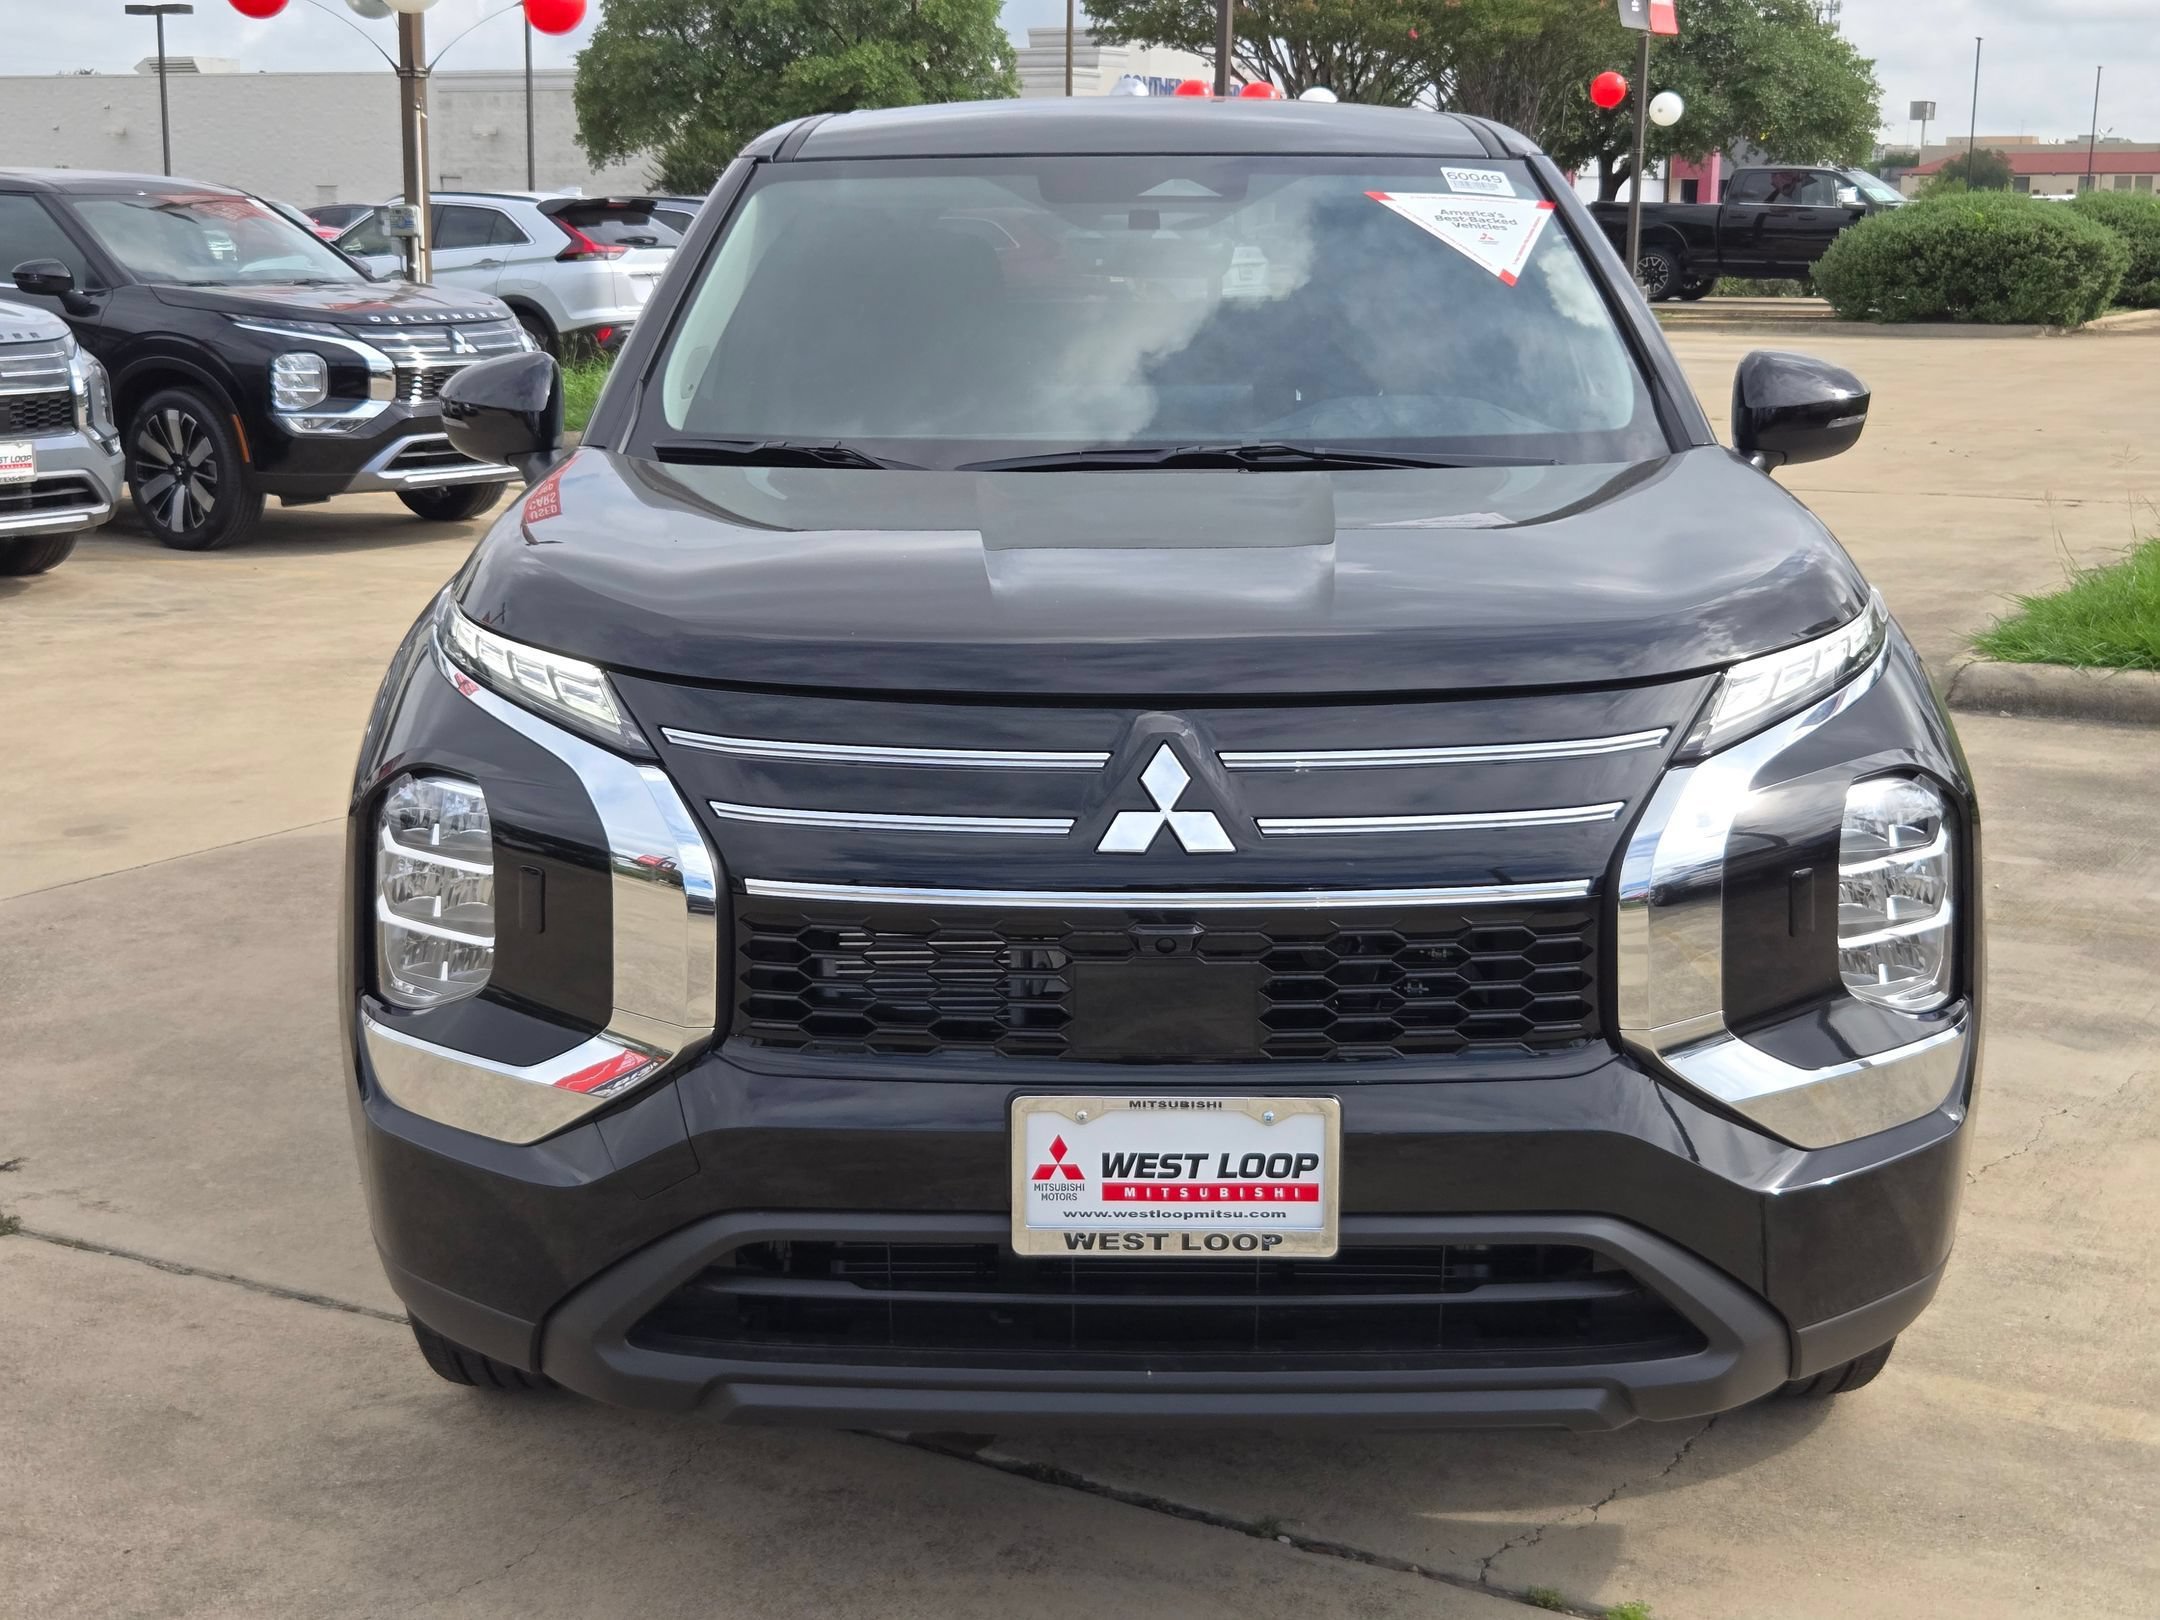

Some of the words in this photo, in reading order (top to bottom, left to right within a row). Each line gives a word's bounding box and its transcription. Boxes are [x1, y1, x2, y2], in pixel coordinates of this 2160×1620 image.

[1446, 171, 1503, 184] 60049
[1440, 209, 1505, 218] America's
[1451, 221, 1508, 231] Vehicles
[368, 311, 499, 323] OUTLANDER
[11, 455, 32, 463] LOOP
[1129, 1100, 1223, 1109] MITSUBISHI
[1102, 1152, 1209, 1179] WEST
[1217, 1152, 1320, 1179] LOOP
[1033, 1183, 1085, 1192] MITSUBISHI
[1124, 1187, 1300, 1198] MITSUBISHI
[1041, 1192, 1078, 1201] MOTORS
[1063, 1209, 1287, 1220] www.westloopmitsu.com
[1064, 1232, 1169, 1251] WEST
[1189, 1232, 1284, 1251] LOOP
